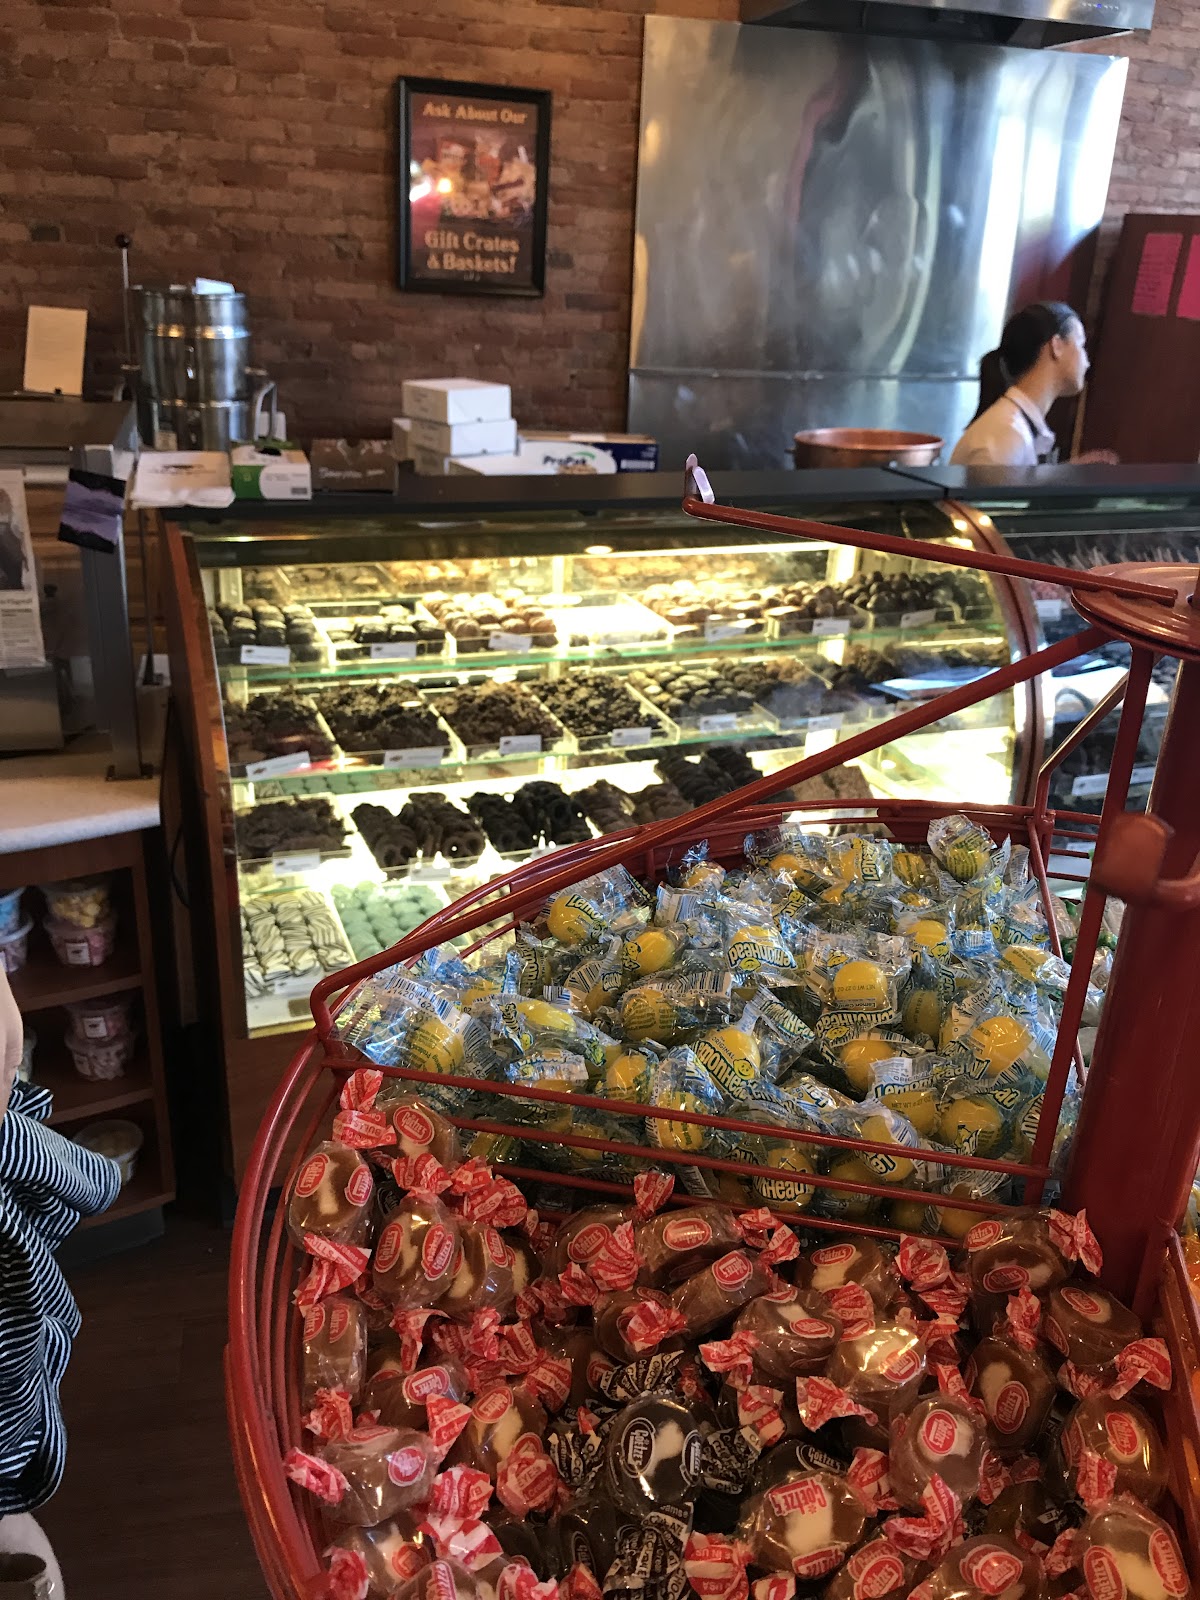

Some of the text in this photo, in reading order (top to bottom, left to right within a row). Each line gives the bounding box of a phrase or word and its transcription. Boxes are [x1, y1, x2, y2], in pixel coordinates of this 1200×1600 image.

[422, 102, 527, 125] Ask About Our
[424, 230, 519, 252] Gift Crates
[427, 253, 440, 270] &
